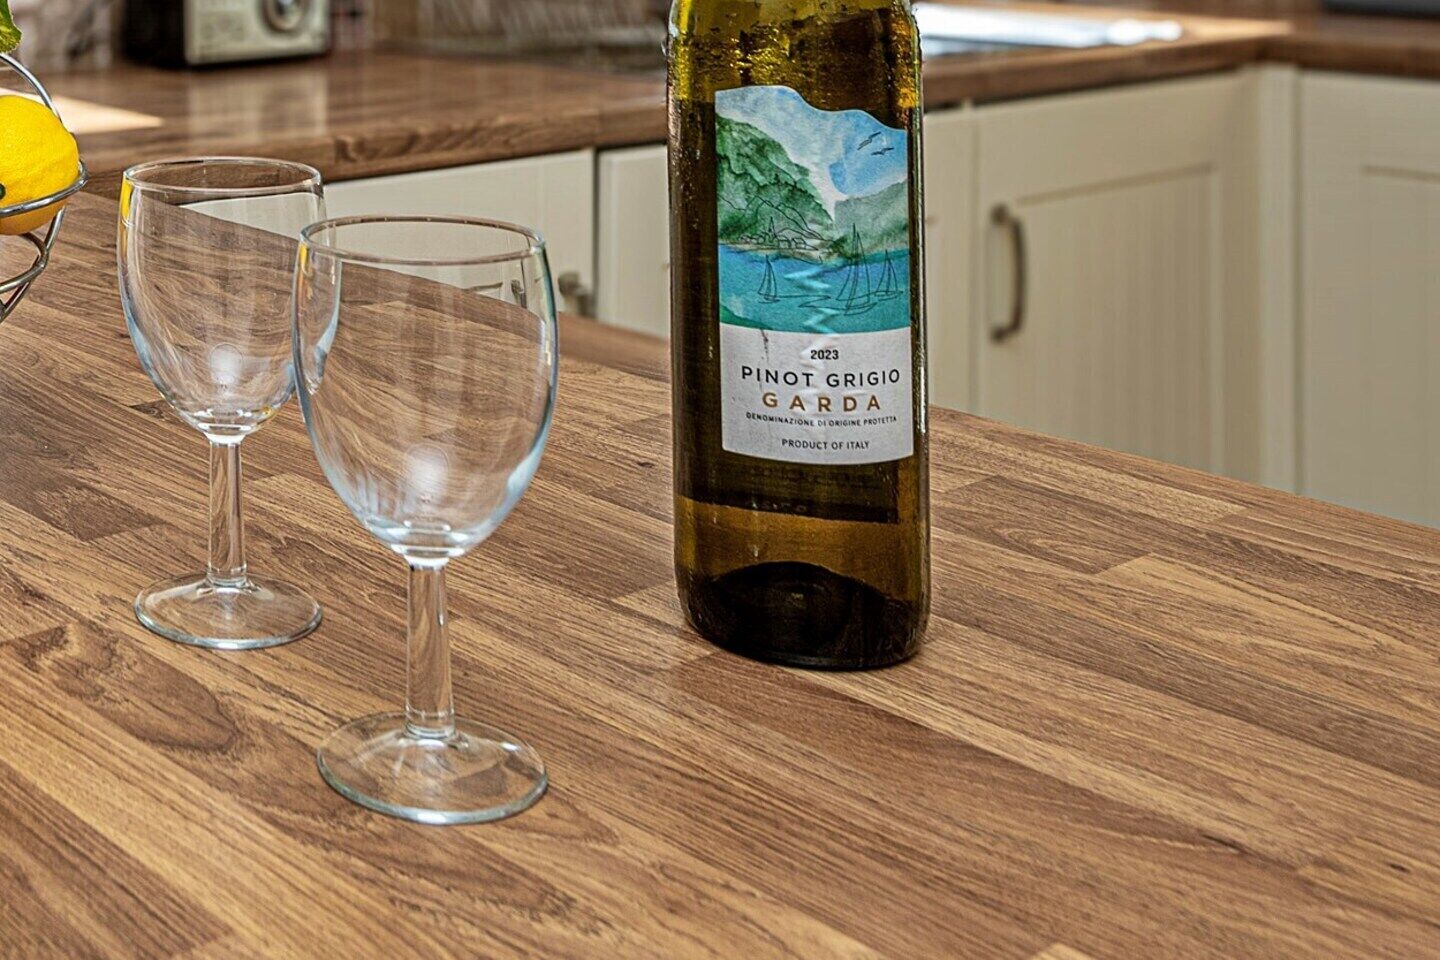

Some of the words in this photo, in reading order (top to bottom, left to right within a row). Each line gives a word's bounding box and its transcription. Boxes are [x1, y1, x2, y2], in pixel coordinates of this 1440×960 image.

[810, 349, 839, 360] 2023
[741, 365, 814, 387] PINOT
[826, 368, 900, 388] GRIGIO
[762, 392, 881, 412] GARDA
[745, 411, 815, 427] DENOMINAZIONE
[817, 419, 827, 428] DI
[828, 419, 862, 427] ORIGINE
[863, 415, 897, 426] PROTETTA
[781, 438, 828, 450] PRODUCT
[831, 441, 844, 450] OF
[846, 440, 870, 449] ITALY
